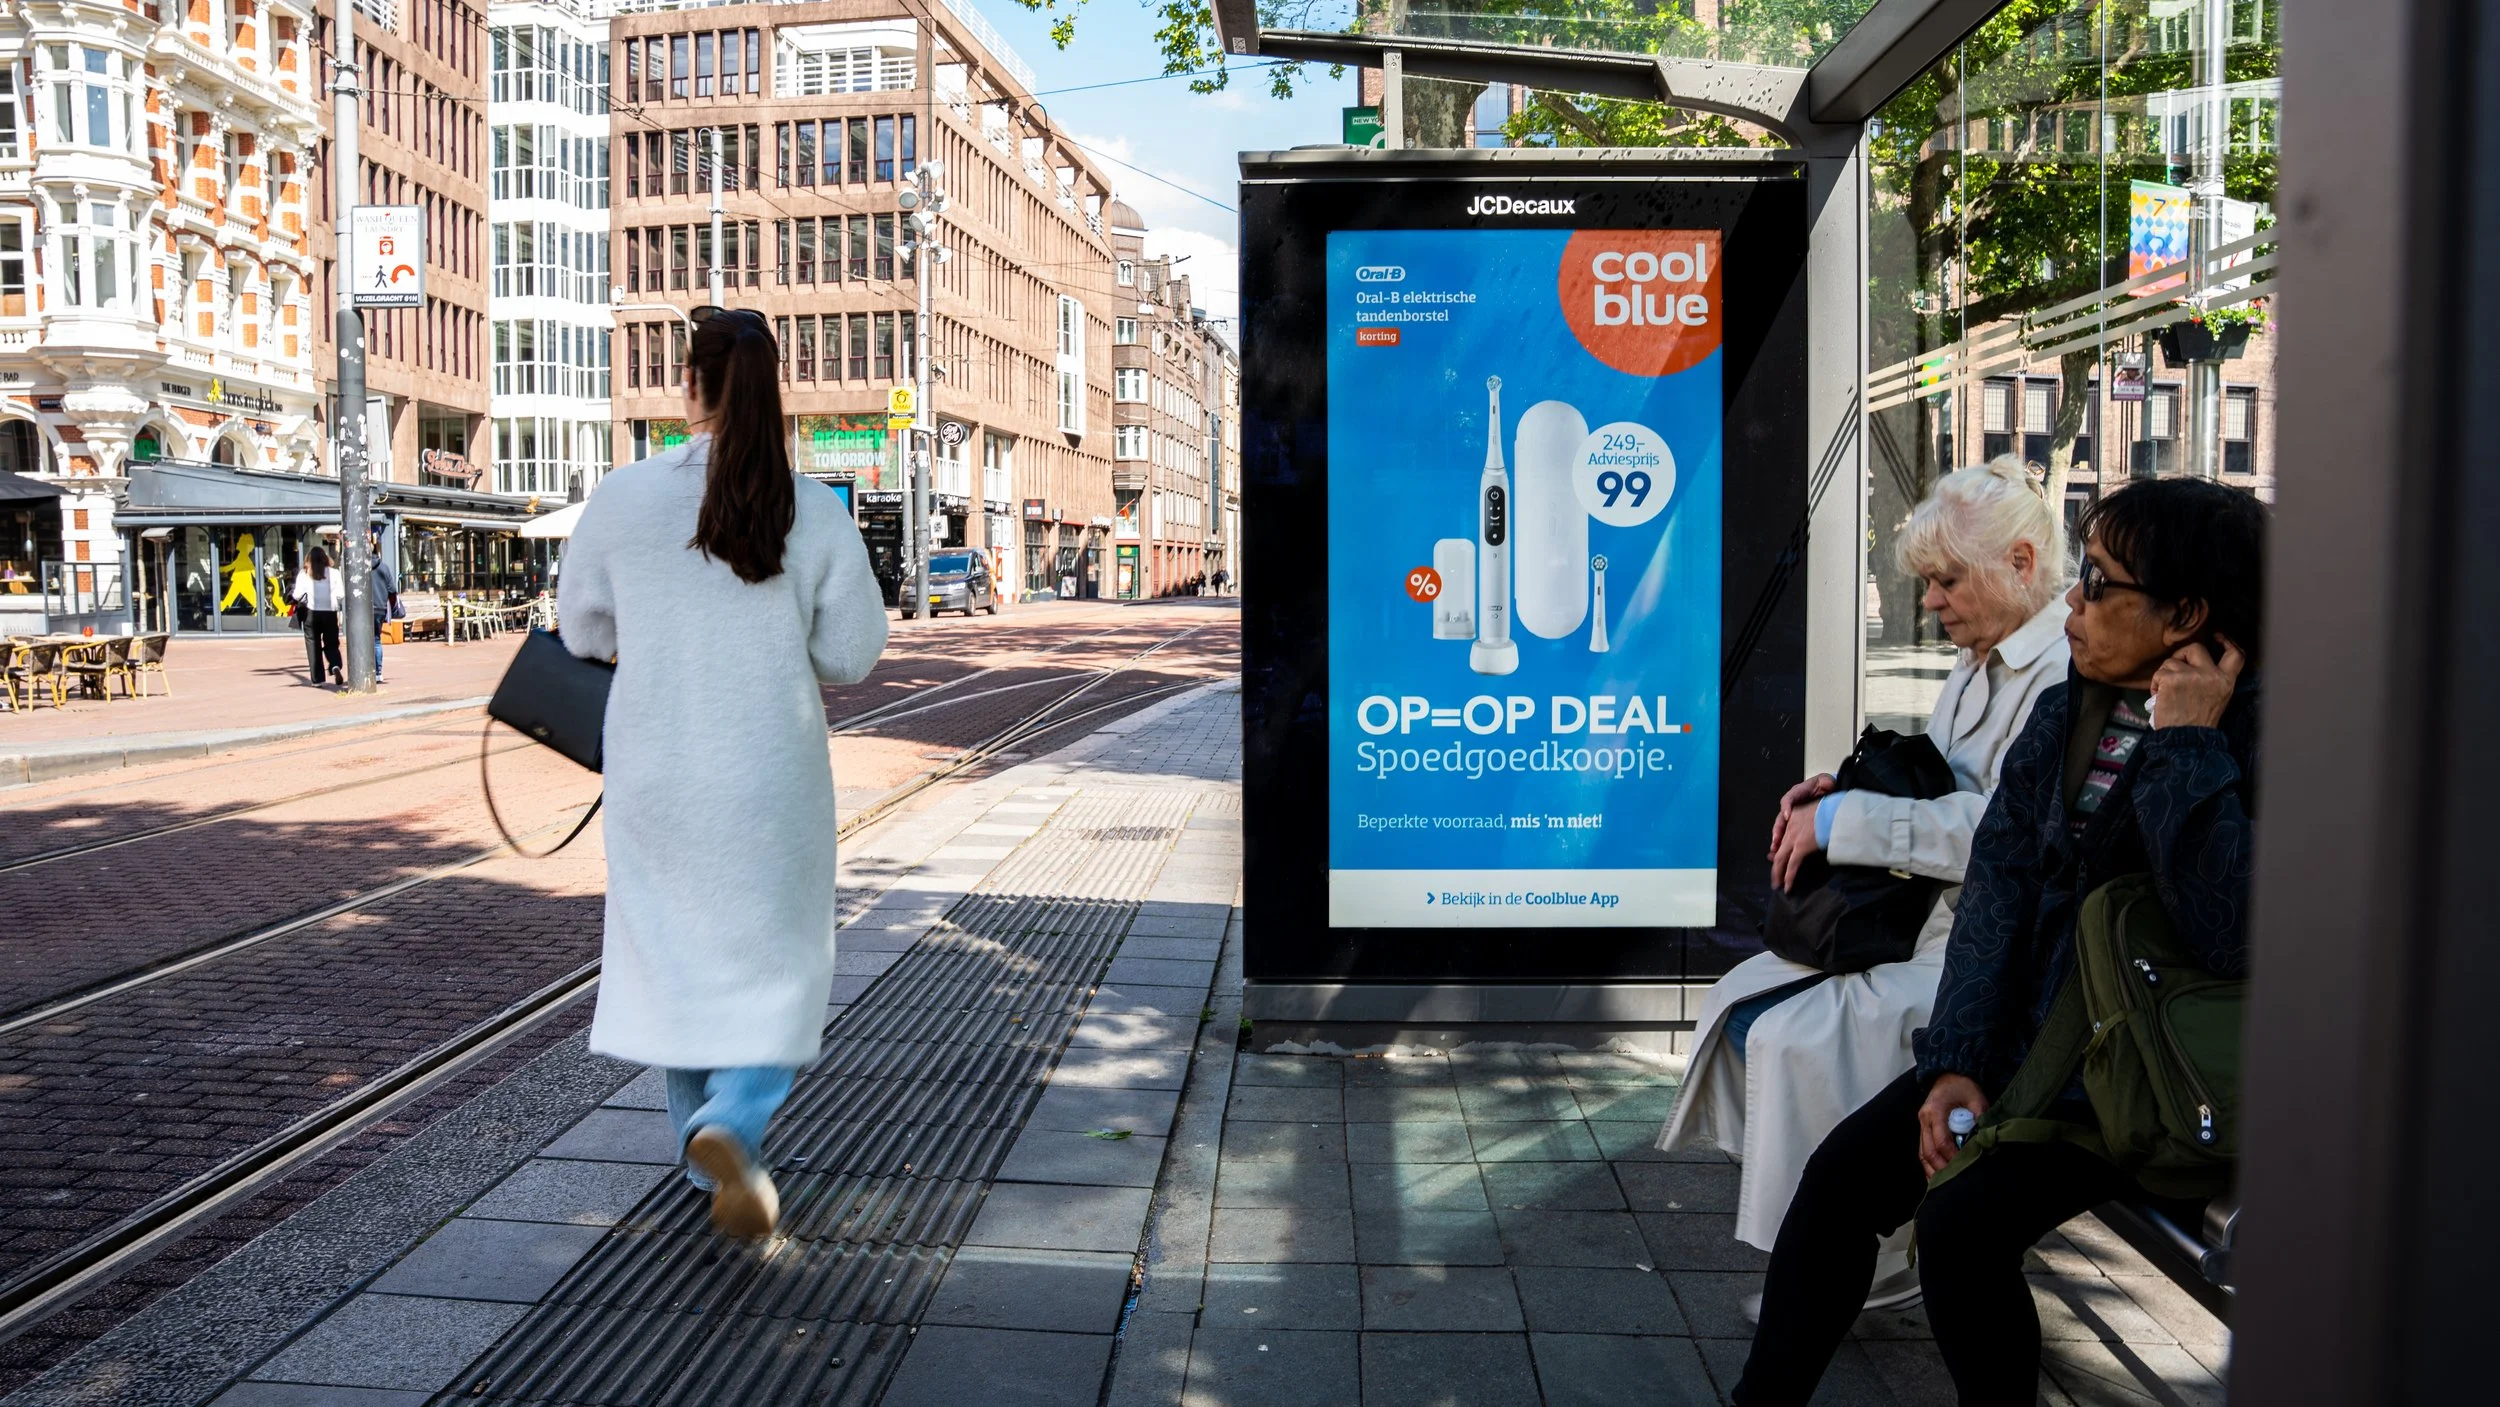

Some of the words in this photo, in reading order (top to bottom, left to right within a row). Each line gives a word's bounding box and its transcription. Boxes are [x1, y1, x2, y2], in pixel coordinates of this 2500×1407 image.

[1467, 195, 1576, 216] JCDecaux
[1592, 242, 1709, 283] cool
[1358, 267, 1402, 281] Oral-B
[1356, 291, 1400, 304] Oral-B
[1403, 291, 1476, 304] elektrische
[1594, 284, 1709, 326] blue
[1356, 309, 1449, 322] tandenborstel
[1359, 331, 1397, 343] korting
[814, 430, 886, 450] REGREEN
[814, 451, 887, 468] TOMORROW
[1588, 453, 1660, 468] Adviesprijs
[1596, 470, 1652, 508] 99
[866, 493, 902, 504] karaoke
[1410, 573, 1437, 597] %
[1357, 695, 1536, 735] OP=OP
[1551, 695, 1692, 734] DEAL.
[1357, 741, 1673, 779] Spoedgoedkoopje.
[1358, 813, 1428, 831] Beperkte
[1432, 814, 1507, 830] voorraad,
[1511, 814, 1540, 828] mis
[1544, 814, 1564, 828] 'm
[1567, 814, 1602, 828] niet!
[1442, 892, 1485, 909] Bekijk
[1489, 892, 1502, 905] in
[1504, 892, 1522, 905] de
[1525, 892, 1587, 905] Coolblue
[1590, 892, 1619, 908] App
